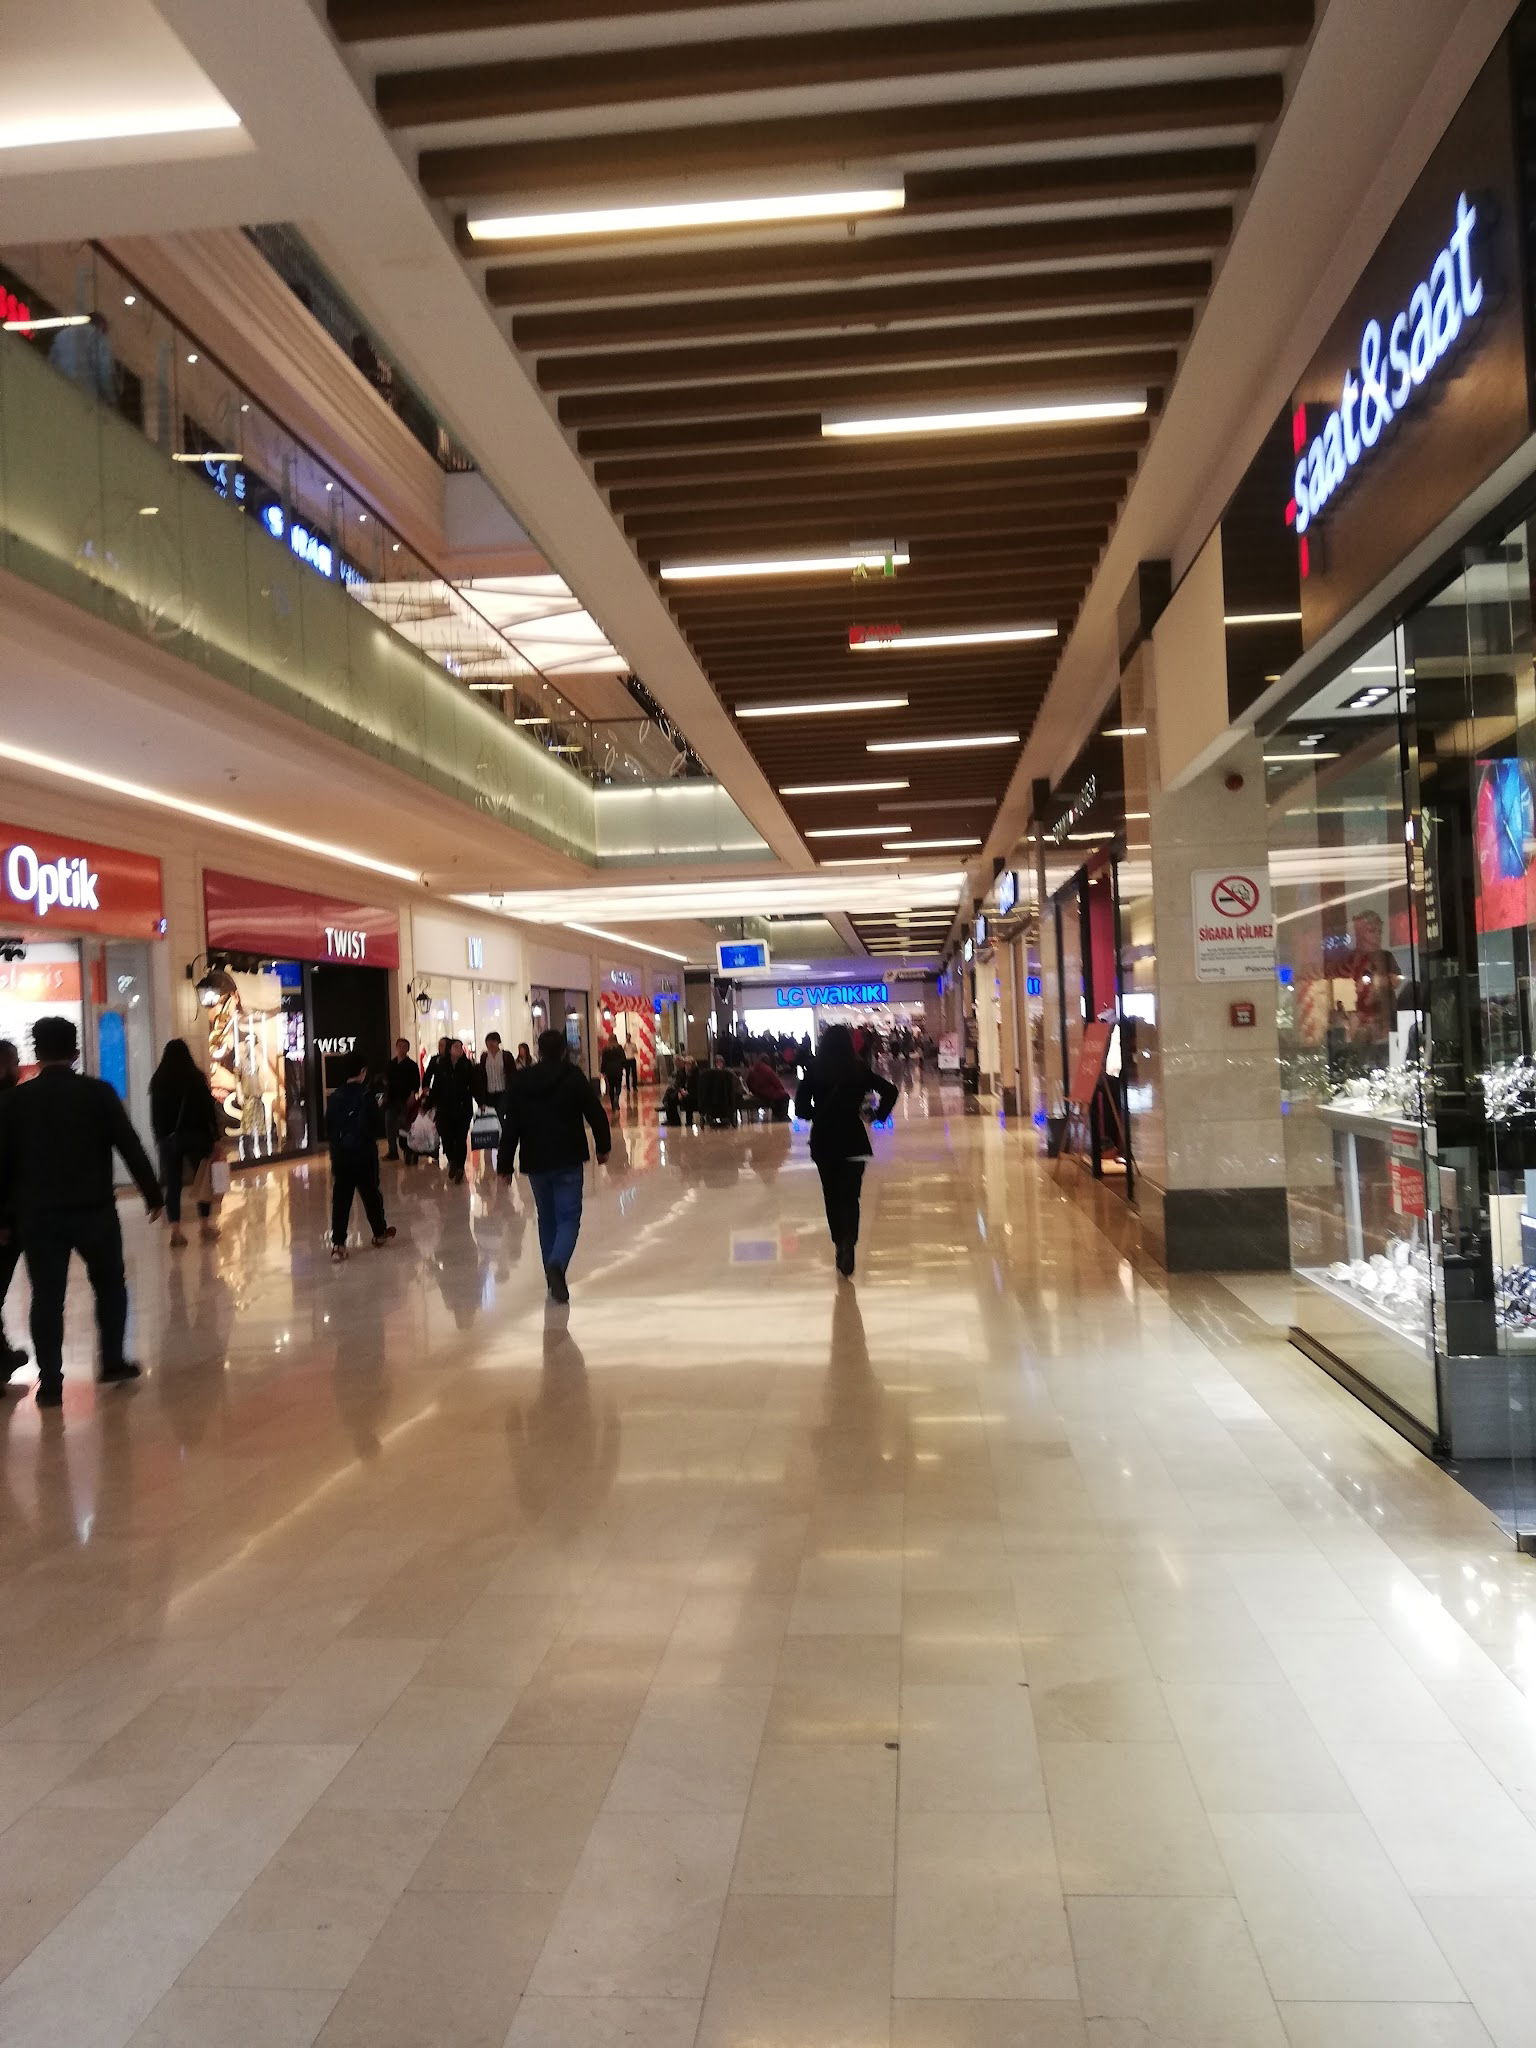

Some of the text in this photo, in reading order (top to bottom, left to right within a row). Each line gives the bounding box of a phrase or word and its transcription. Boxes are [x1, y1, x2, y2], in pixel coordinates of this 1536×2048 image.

[1294, 190, 1483, 534] saat&saat
[8, 844, 99, 916] Optik
[324, 927, 367, 960] TWIST
[1199, 924, 1234, 941] SİGARA
[777, 986, 803, 1006] LC
